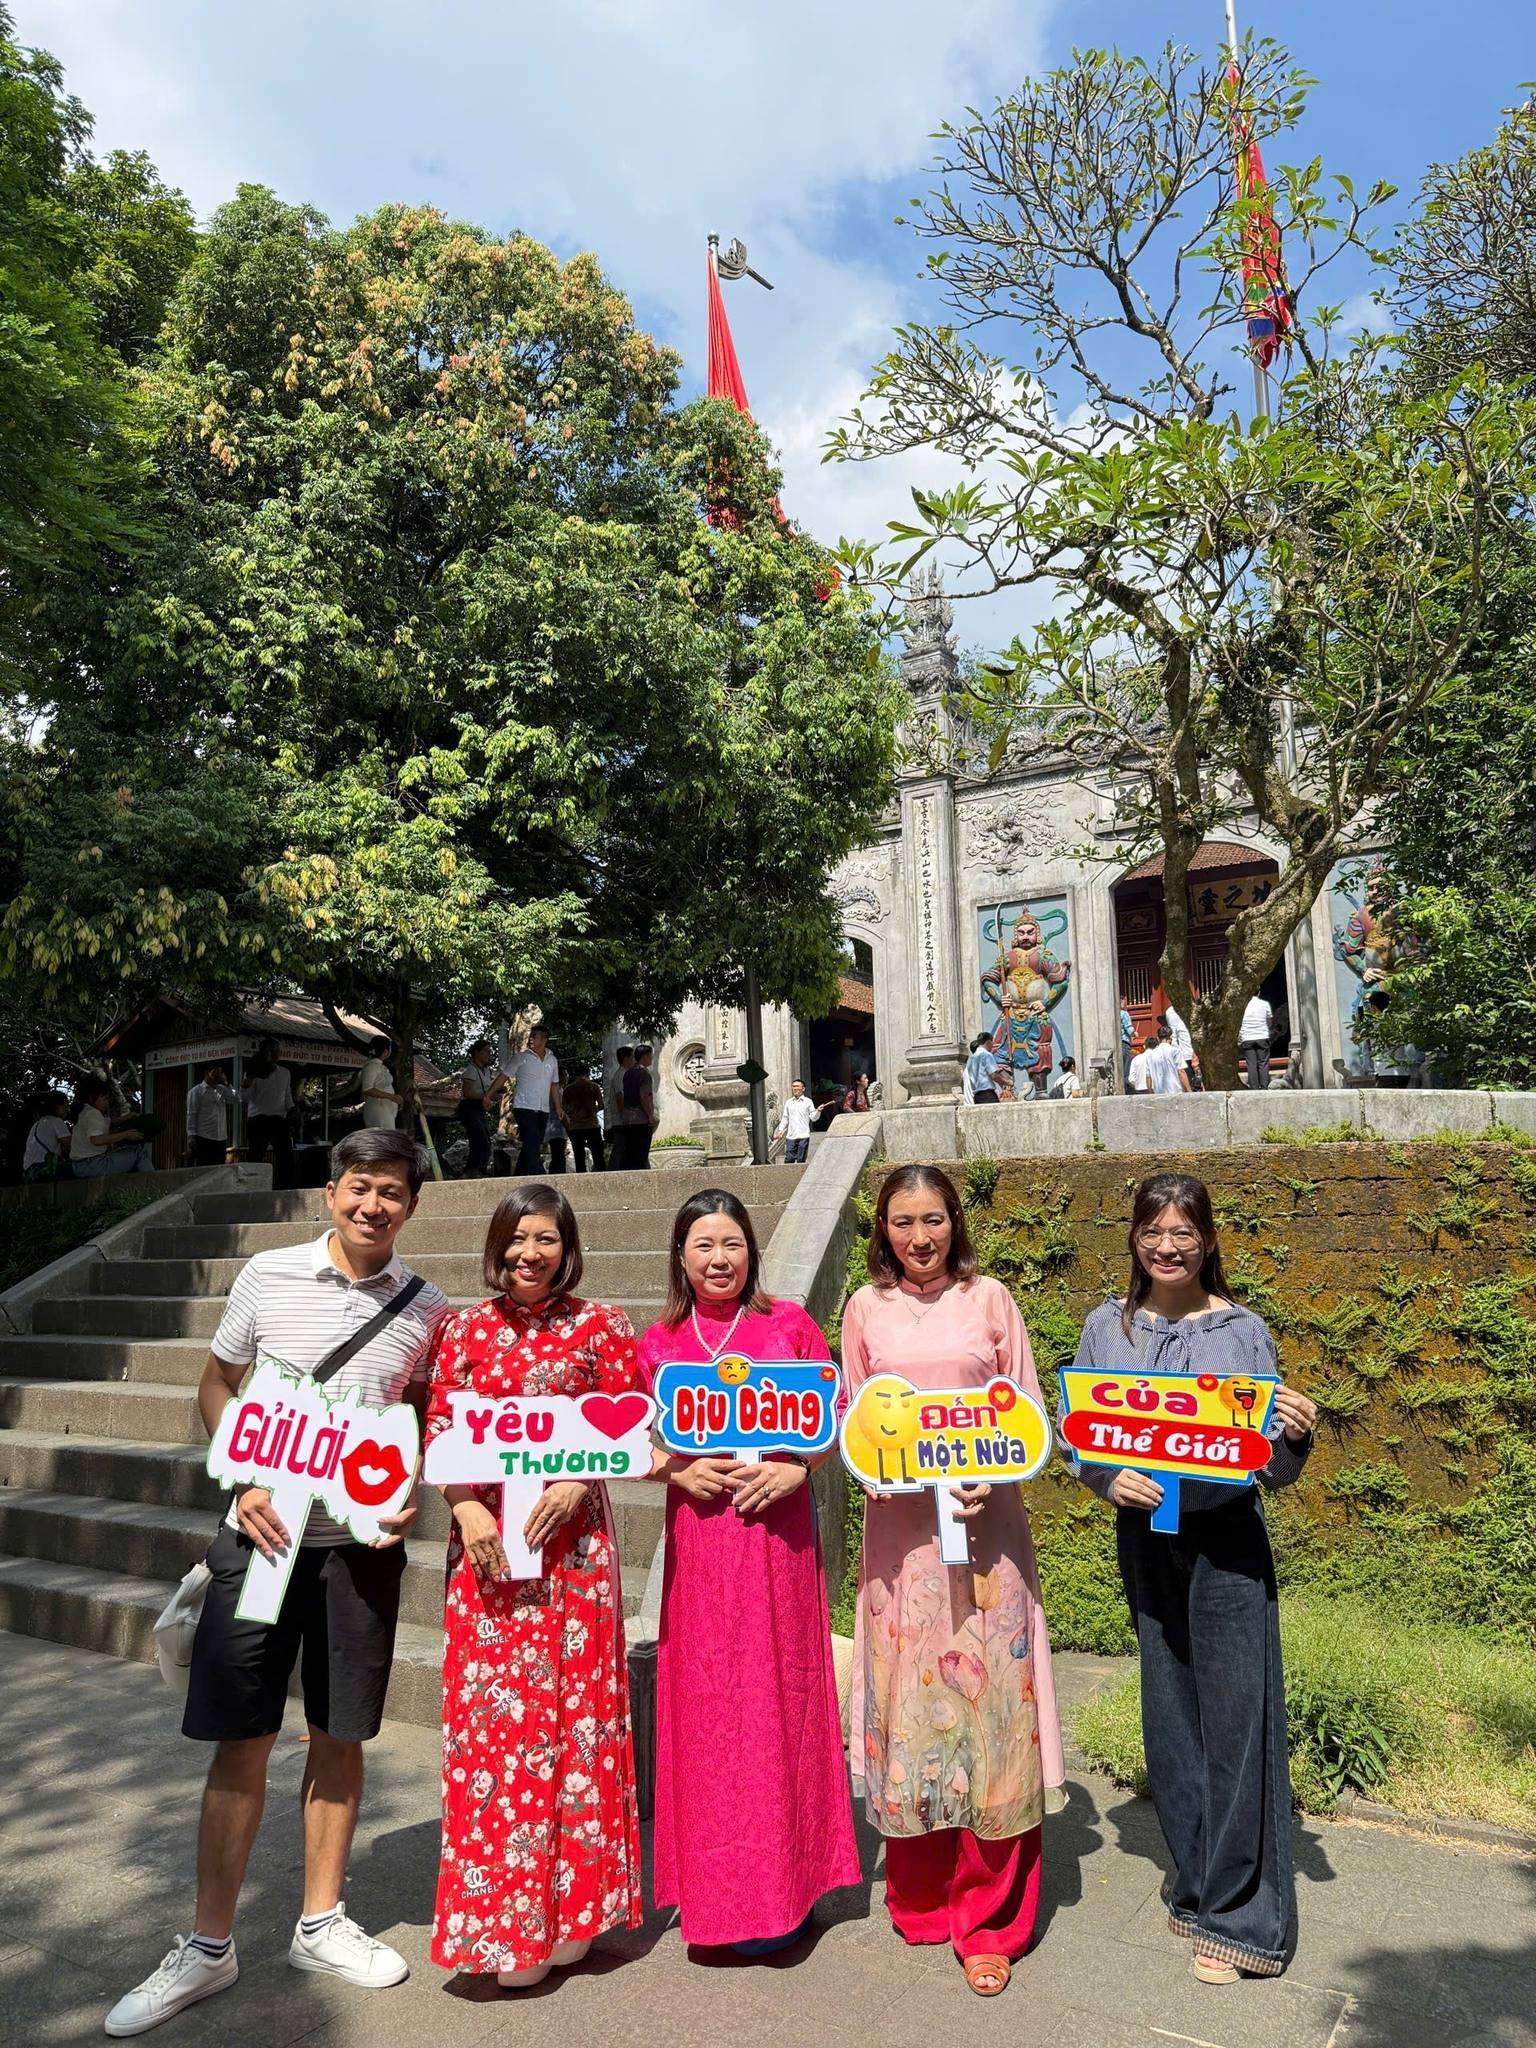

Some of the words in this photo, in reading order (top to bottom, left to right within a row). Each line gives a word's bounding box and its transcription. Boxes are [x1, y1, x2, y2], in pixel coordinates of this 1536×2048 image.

[466, 1402, 555, 1444] Yêu
[676, 1387, 727, 1443] Dịu
[739, 1380, 820, 1437] Dàng
[919, 1396, 997, 1429] Đến
[228, 1401, 293, 1470] Gửi
[286, 1411, 350, 1480] Lời
[917, 1434, 968, 1474] Một
[975, 1430, 1026, 1465] Nửa
[1088, 1422, 1161, 1453] Thế
[1164, 1432, 1241, 1463] Giới
[499, 1448, 630, 1475] Thương
[476, 1635, 508, 1648] CHANEL
[491, 1688, 521, 1721] CHANEL
[571, 1725, 596, 1771] CHANEL
[461, 1883, 499, 1899] CHANEL
